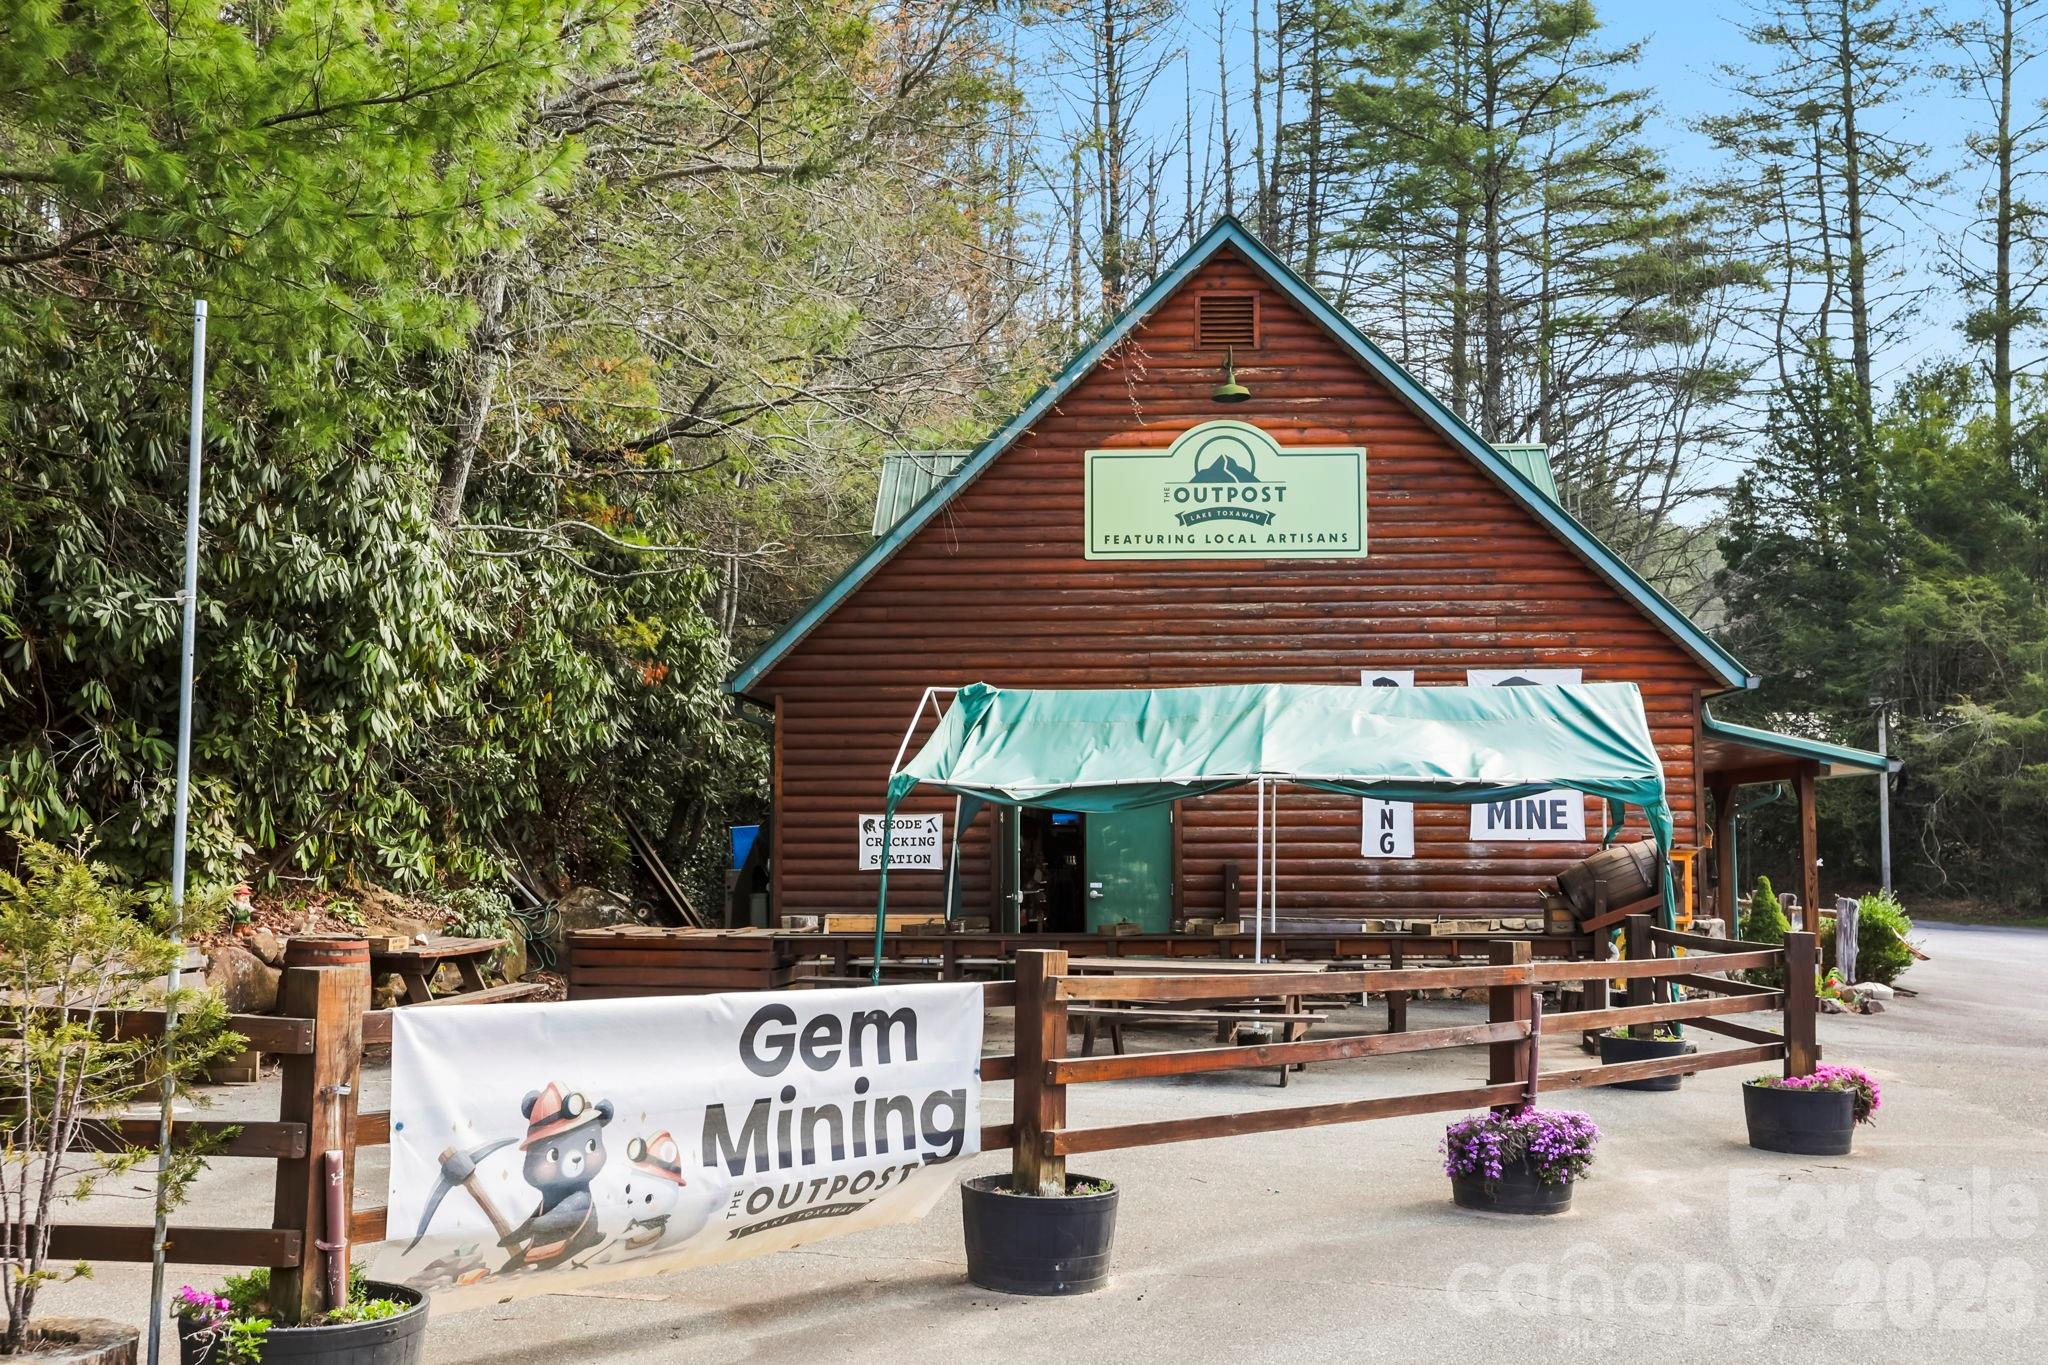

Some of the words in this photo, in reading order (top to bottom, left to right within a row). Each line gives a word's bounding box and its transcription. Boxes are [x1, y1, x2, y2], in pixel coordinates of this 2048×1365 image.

[1173, 486, 1287, 503] OUTPOST
[1190, 511, 1212, 521] LAKE
[1217, 510, 1261, 520] TOXAWAY
[1103, 534, 1196, 545] FEATURING
[1205, 533, 1257, 544] LOCAL
[1267, 532, 1349, 544] ARTISANS
[1487, 799, 1568, 829] MINE
[739, 1003, 918, 1077] Gem
[702, 1076, 967, 1177] Mining
[726, 1189, 744, 1220] THE
[746, 1162, 918, 1215] OUTPOST
